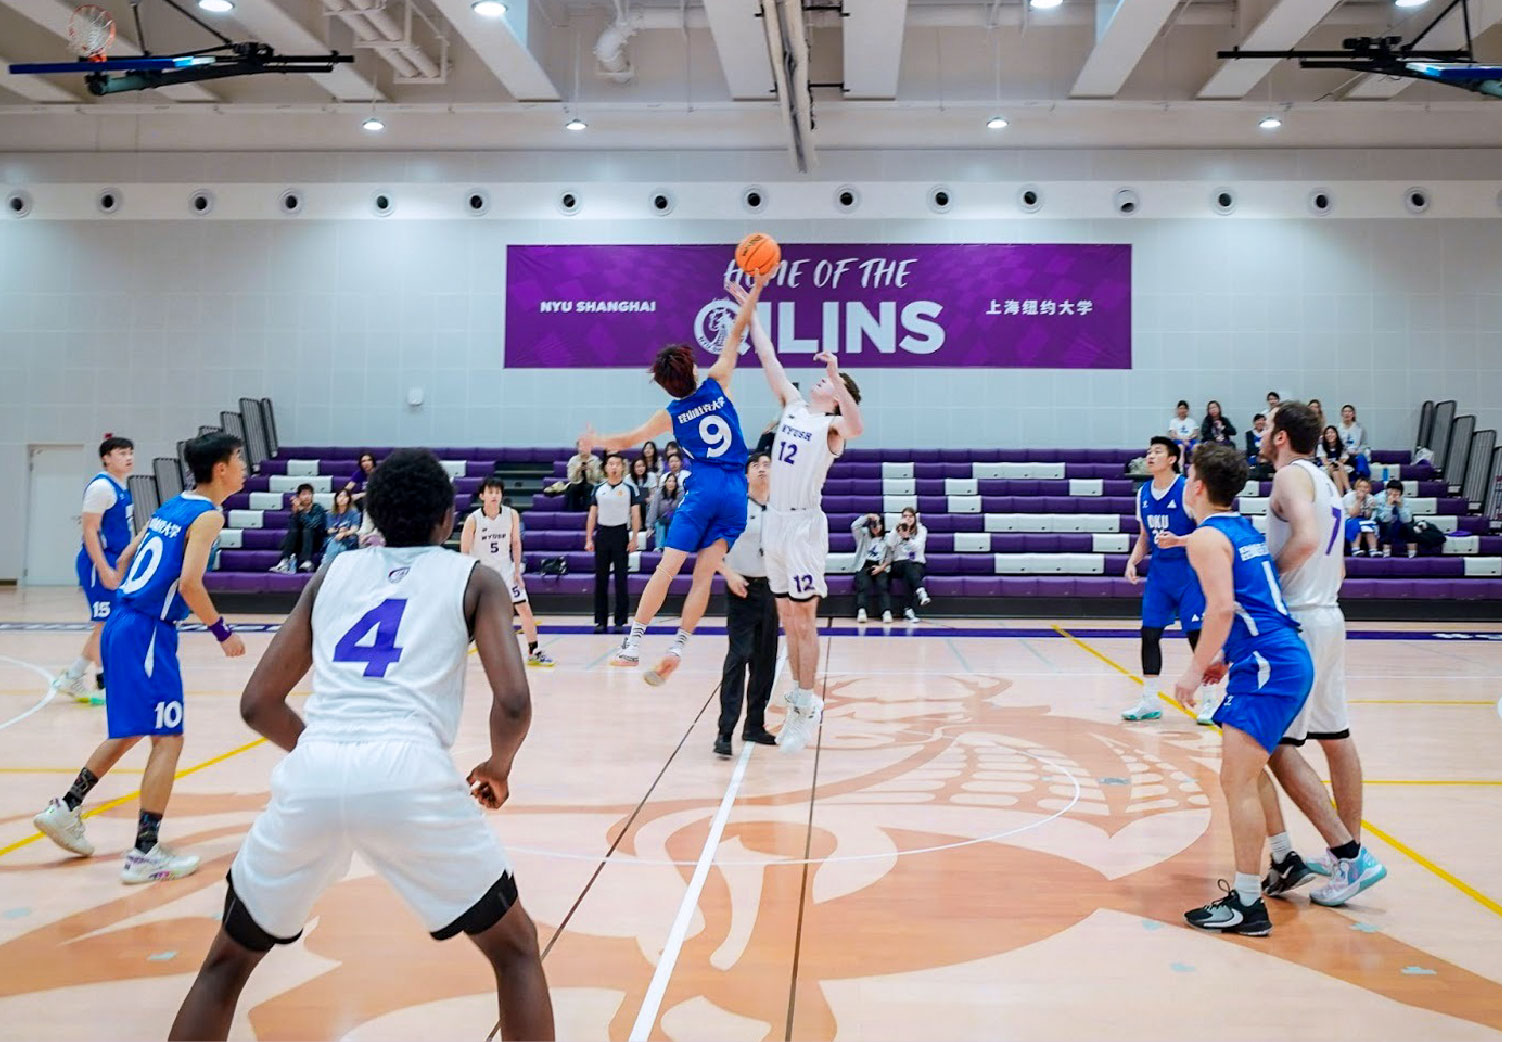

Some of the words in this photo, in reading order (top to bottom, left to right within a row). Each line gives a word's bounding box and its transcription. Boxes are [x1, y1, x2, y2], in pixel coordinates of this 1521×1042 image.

[813, 257, 859, 289] OF
[858, 257, 917, 289] THE
[540, 301, 573, 313] NYU
[576, 301, 656, 313] SHANGHAI
[985, 299, 1093, 316] 上海纽约大学
[698, 415, 733, 458] 9
[777, 441, 798, 464] 12
[490, 542, 499, 553] 5
[511, 585, 521, 598] 5
[794, 574, 815, 592] 12
[93, 600, 111, 618] 15
[333, 598, 408, 677] 4
[154, 701, 182, 729] 10
